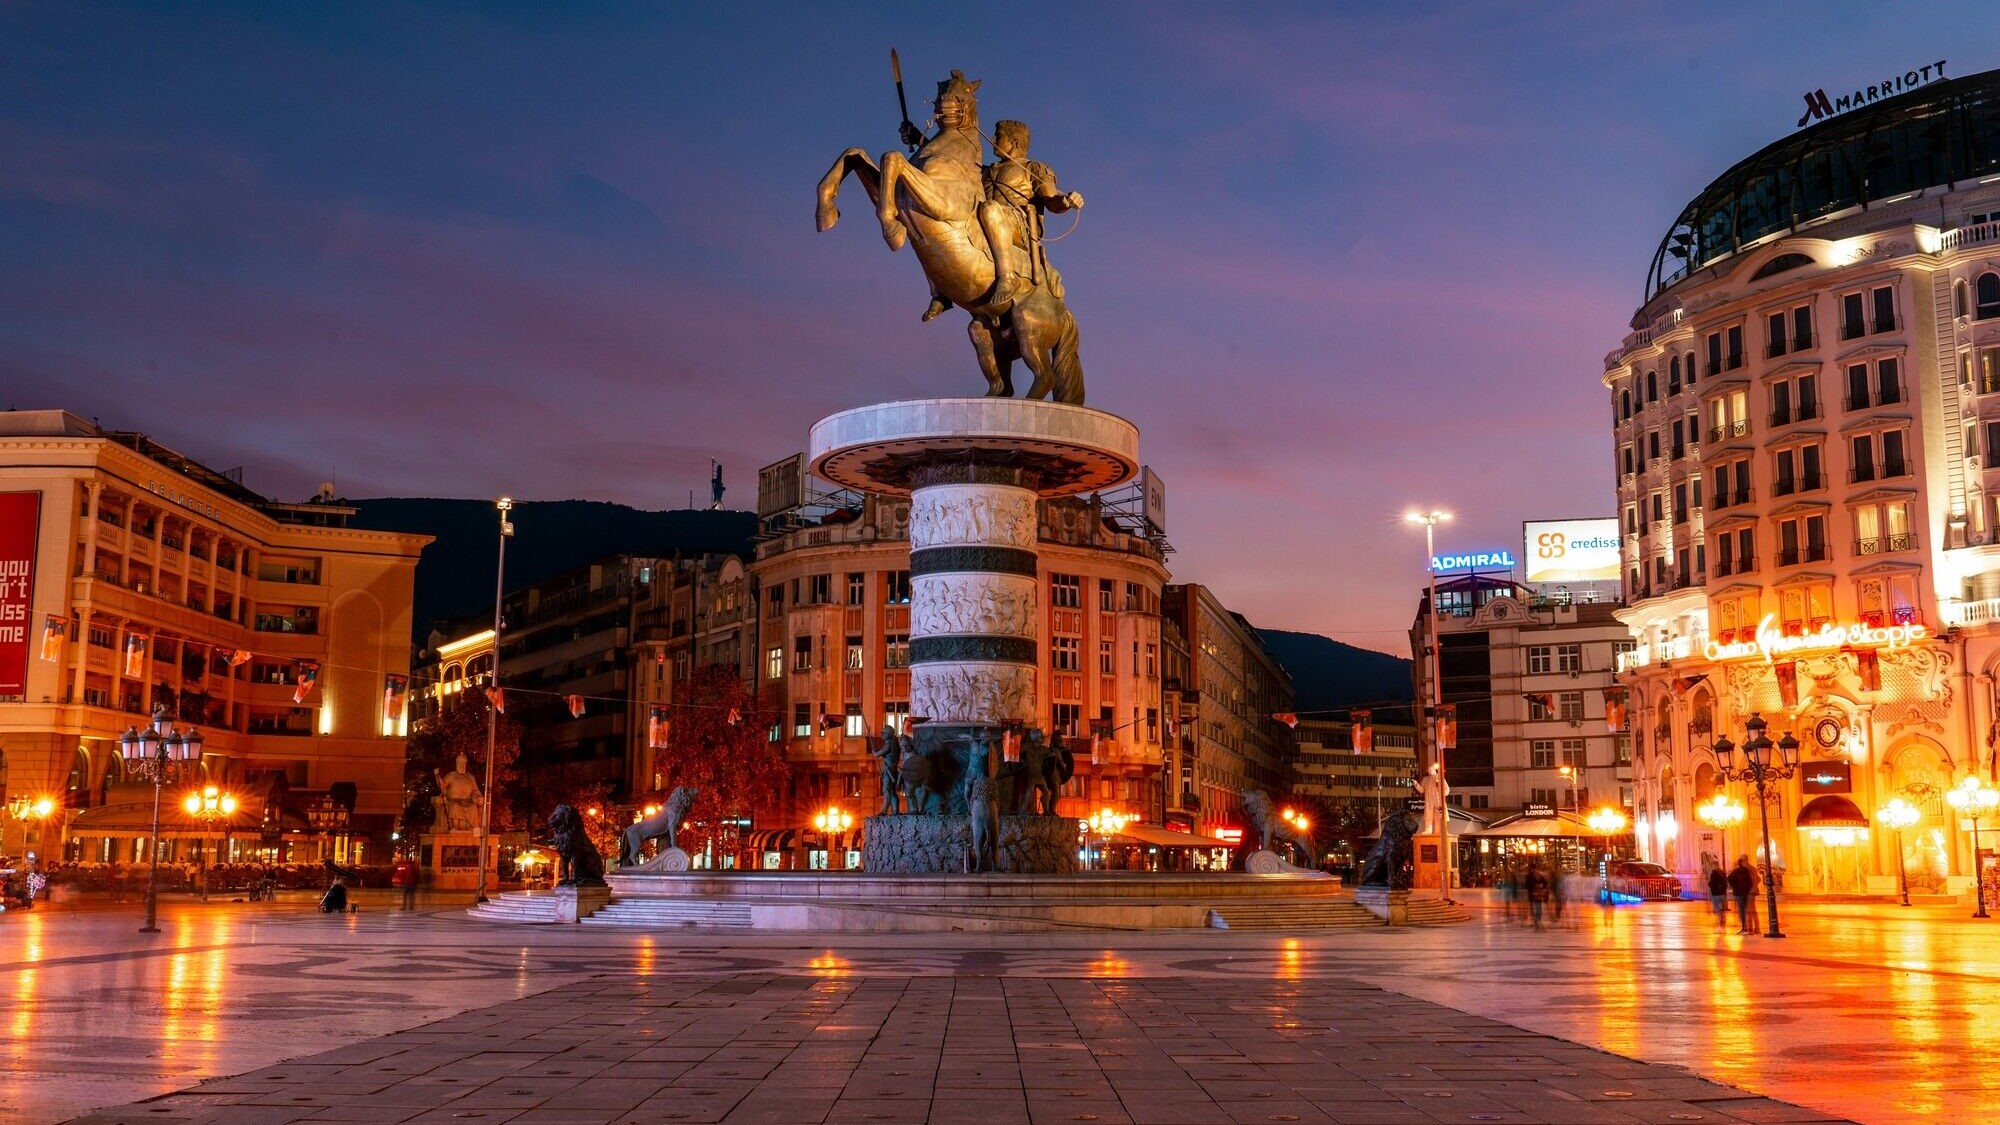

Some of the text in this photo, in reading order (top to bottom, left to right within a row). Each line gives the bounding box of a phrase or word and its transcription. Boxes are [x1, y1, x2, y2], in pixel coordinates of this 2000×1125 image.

[1836, 60, 1946, 112] MARRIOTT
[0, 560, 29, 582] you
[1427, 551, 1515, 571] ADMIRAL
[0, 599, 26, 620] iss
[0, 627, 24, 642] me
